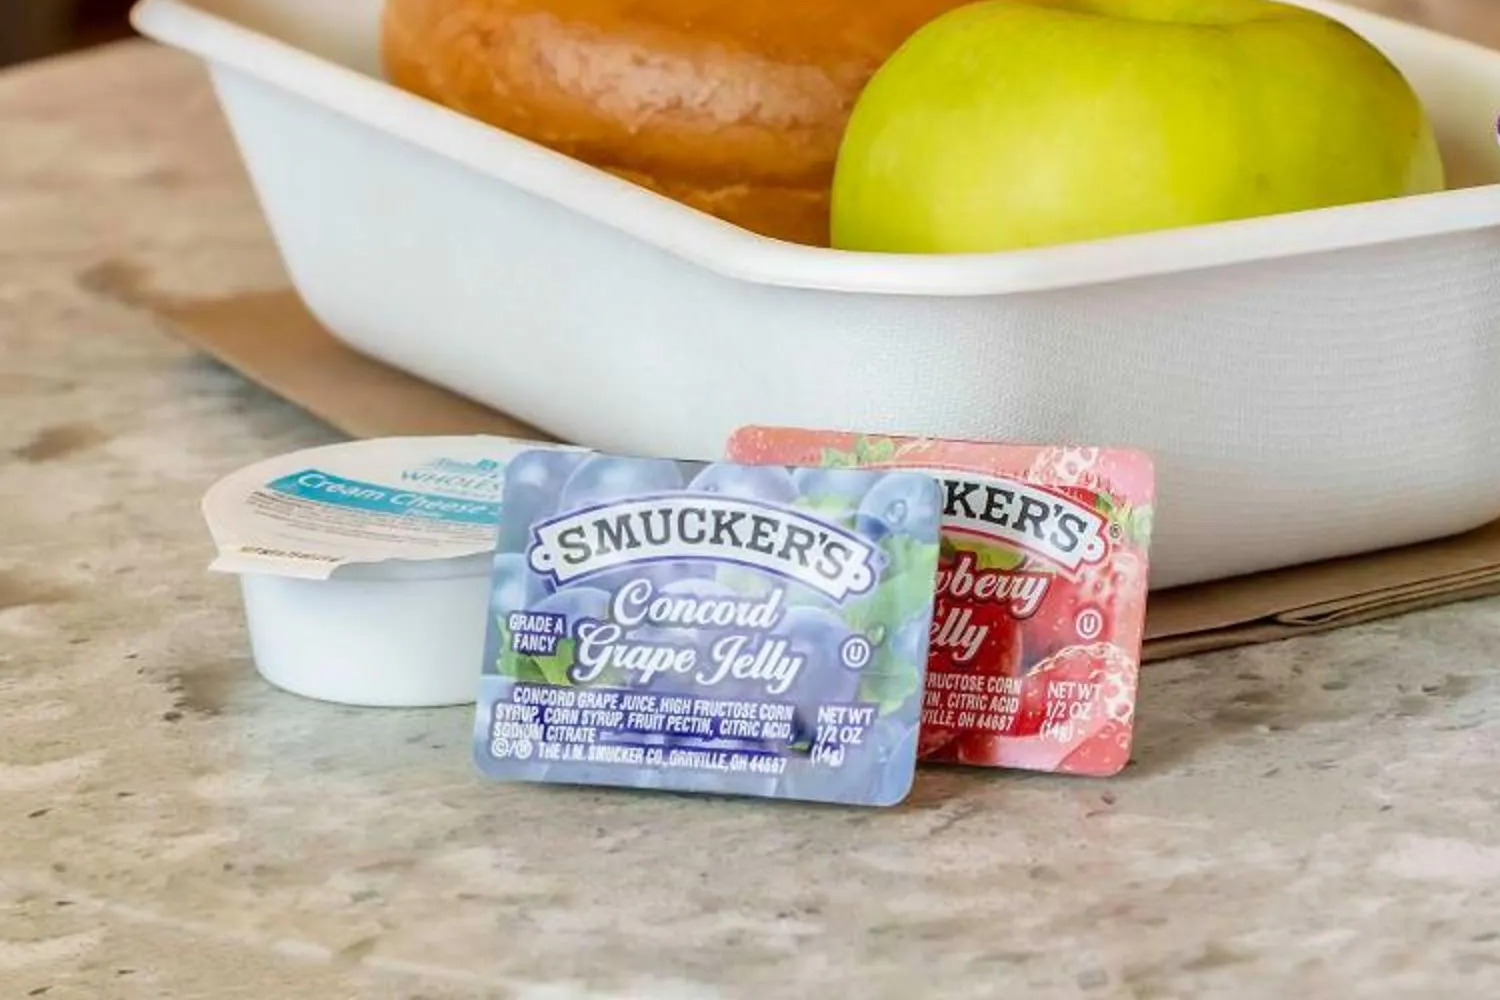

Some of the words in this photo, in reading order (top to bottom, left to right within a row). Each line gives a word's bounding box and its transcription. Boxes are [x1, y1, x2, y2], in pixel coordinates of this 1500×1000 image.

[298, 472, 385, 500] Cream
[389, 493, 489, 516] Cheese
[556, 507, 854, 581] SMUCKER'S
[611, 577, 784, 629] Concord
[509, 613, 553, 633] GRADE
[553, 617, 563, 635] A
[512, 632, 556, 653] FANCY
[571, 622, 697, 684] Grape
[696, 633, 805, 695] Jelly
[987, 676, 1023, 695] CORN
[1047, 680, 1075, 699] NET
[1076, 682, 1102, 700] WT
[513, 687, 575, 706] CONCORD
[577, 691, 619, 710] GRAPE
[619, 695, 659, 714] JUICE,
[660, 698, 690, 715] HIGH
[692, 699, 757, 719] FRUCTOSE
[759, 703, 795, 722] CORN
[946, 692, 987, 711] CITRIC
[989, 696, 1020, 714] ACID
[1046, 701, 1066, 722] 1/2
[1068, 702, 1092, 719] OZ
[495, 702, 541, 723] SYRUP,
[543, 707, 579, 725] CORN
[581, 709, 624, 729] SYRUP,
[627, 712, 664, 730] FRUIT
[666, 714, 714, 735] PECTIN,
[719, 719, 759, 738] CITRIC
[760, 723, 794, 741] ACID,
[817, 706, 847, 725] NET
[848, 707, 874, 726] WT
[957, 712, 974, 729] OH
[493, 721, 543, 740] SODIUM
[546, 725, 597, 743] CITRATE
[816, 726, 837, 746] 1/2
[839, 727, 863, 744] OZ
[538, 742, 562, 760] THE
[587, 744, 644, 763] SMUCKER
